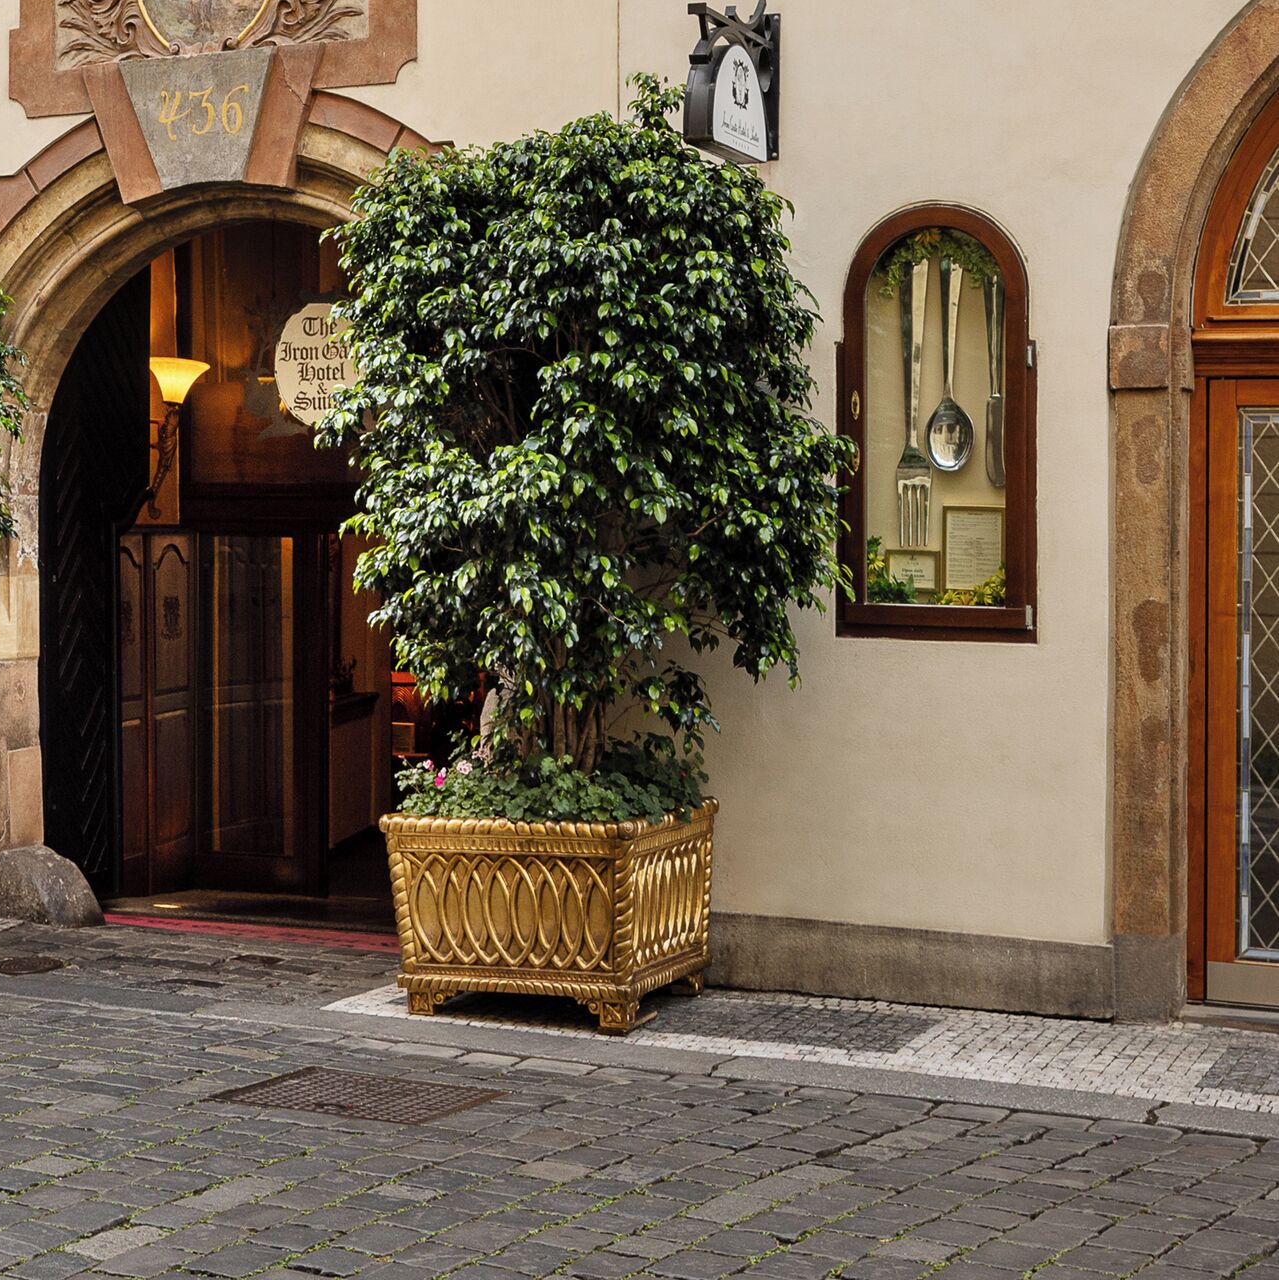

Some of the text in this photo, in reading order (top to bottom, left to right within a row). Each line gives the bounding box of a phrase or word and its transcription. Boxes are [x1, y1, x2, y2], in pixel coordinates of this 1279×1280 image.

[159, 83, 249, 142] 436
[301, 316, 338, 339] The
[280, 341, 350, 362] Iron Ga
[297, 362, 346, 385] Hotel
[317, 382, 327, 395] &
